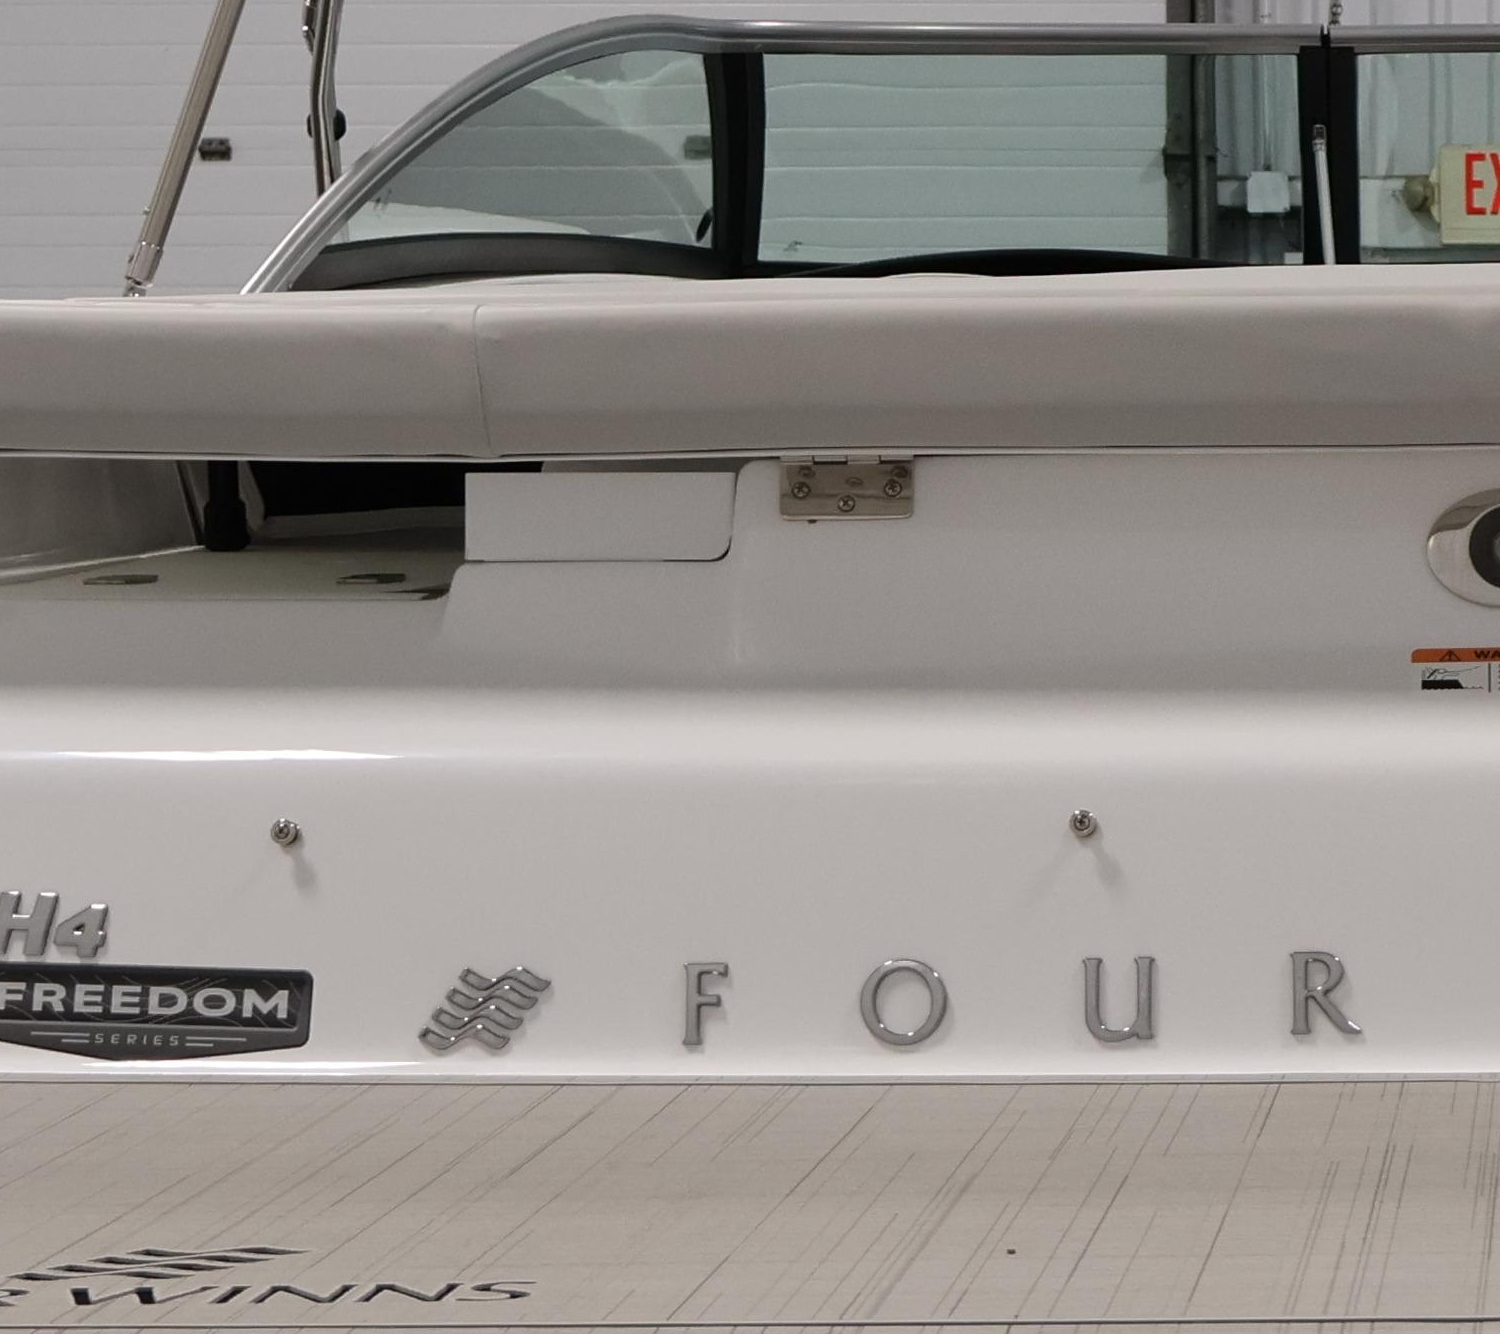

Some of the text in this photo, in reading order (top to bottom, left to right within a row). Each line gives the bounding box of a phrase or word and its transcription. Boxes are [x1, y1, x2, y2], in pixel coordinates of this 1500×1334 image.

[680, 949, 1364, 1049] FOUR
[94, 1032, 180, 1047] SERIES
[67, 1278, 538, 1313] WINNS
